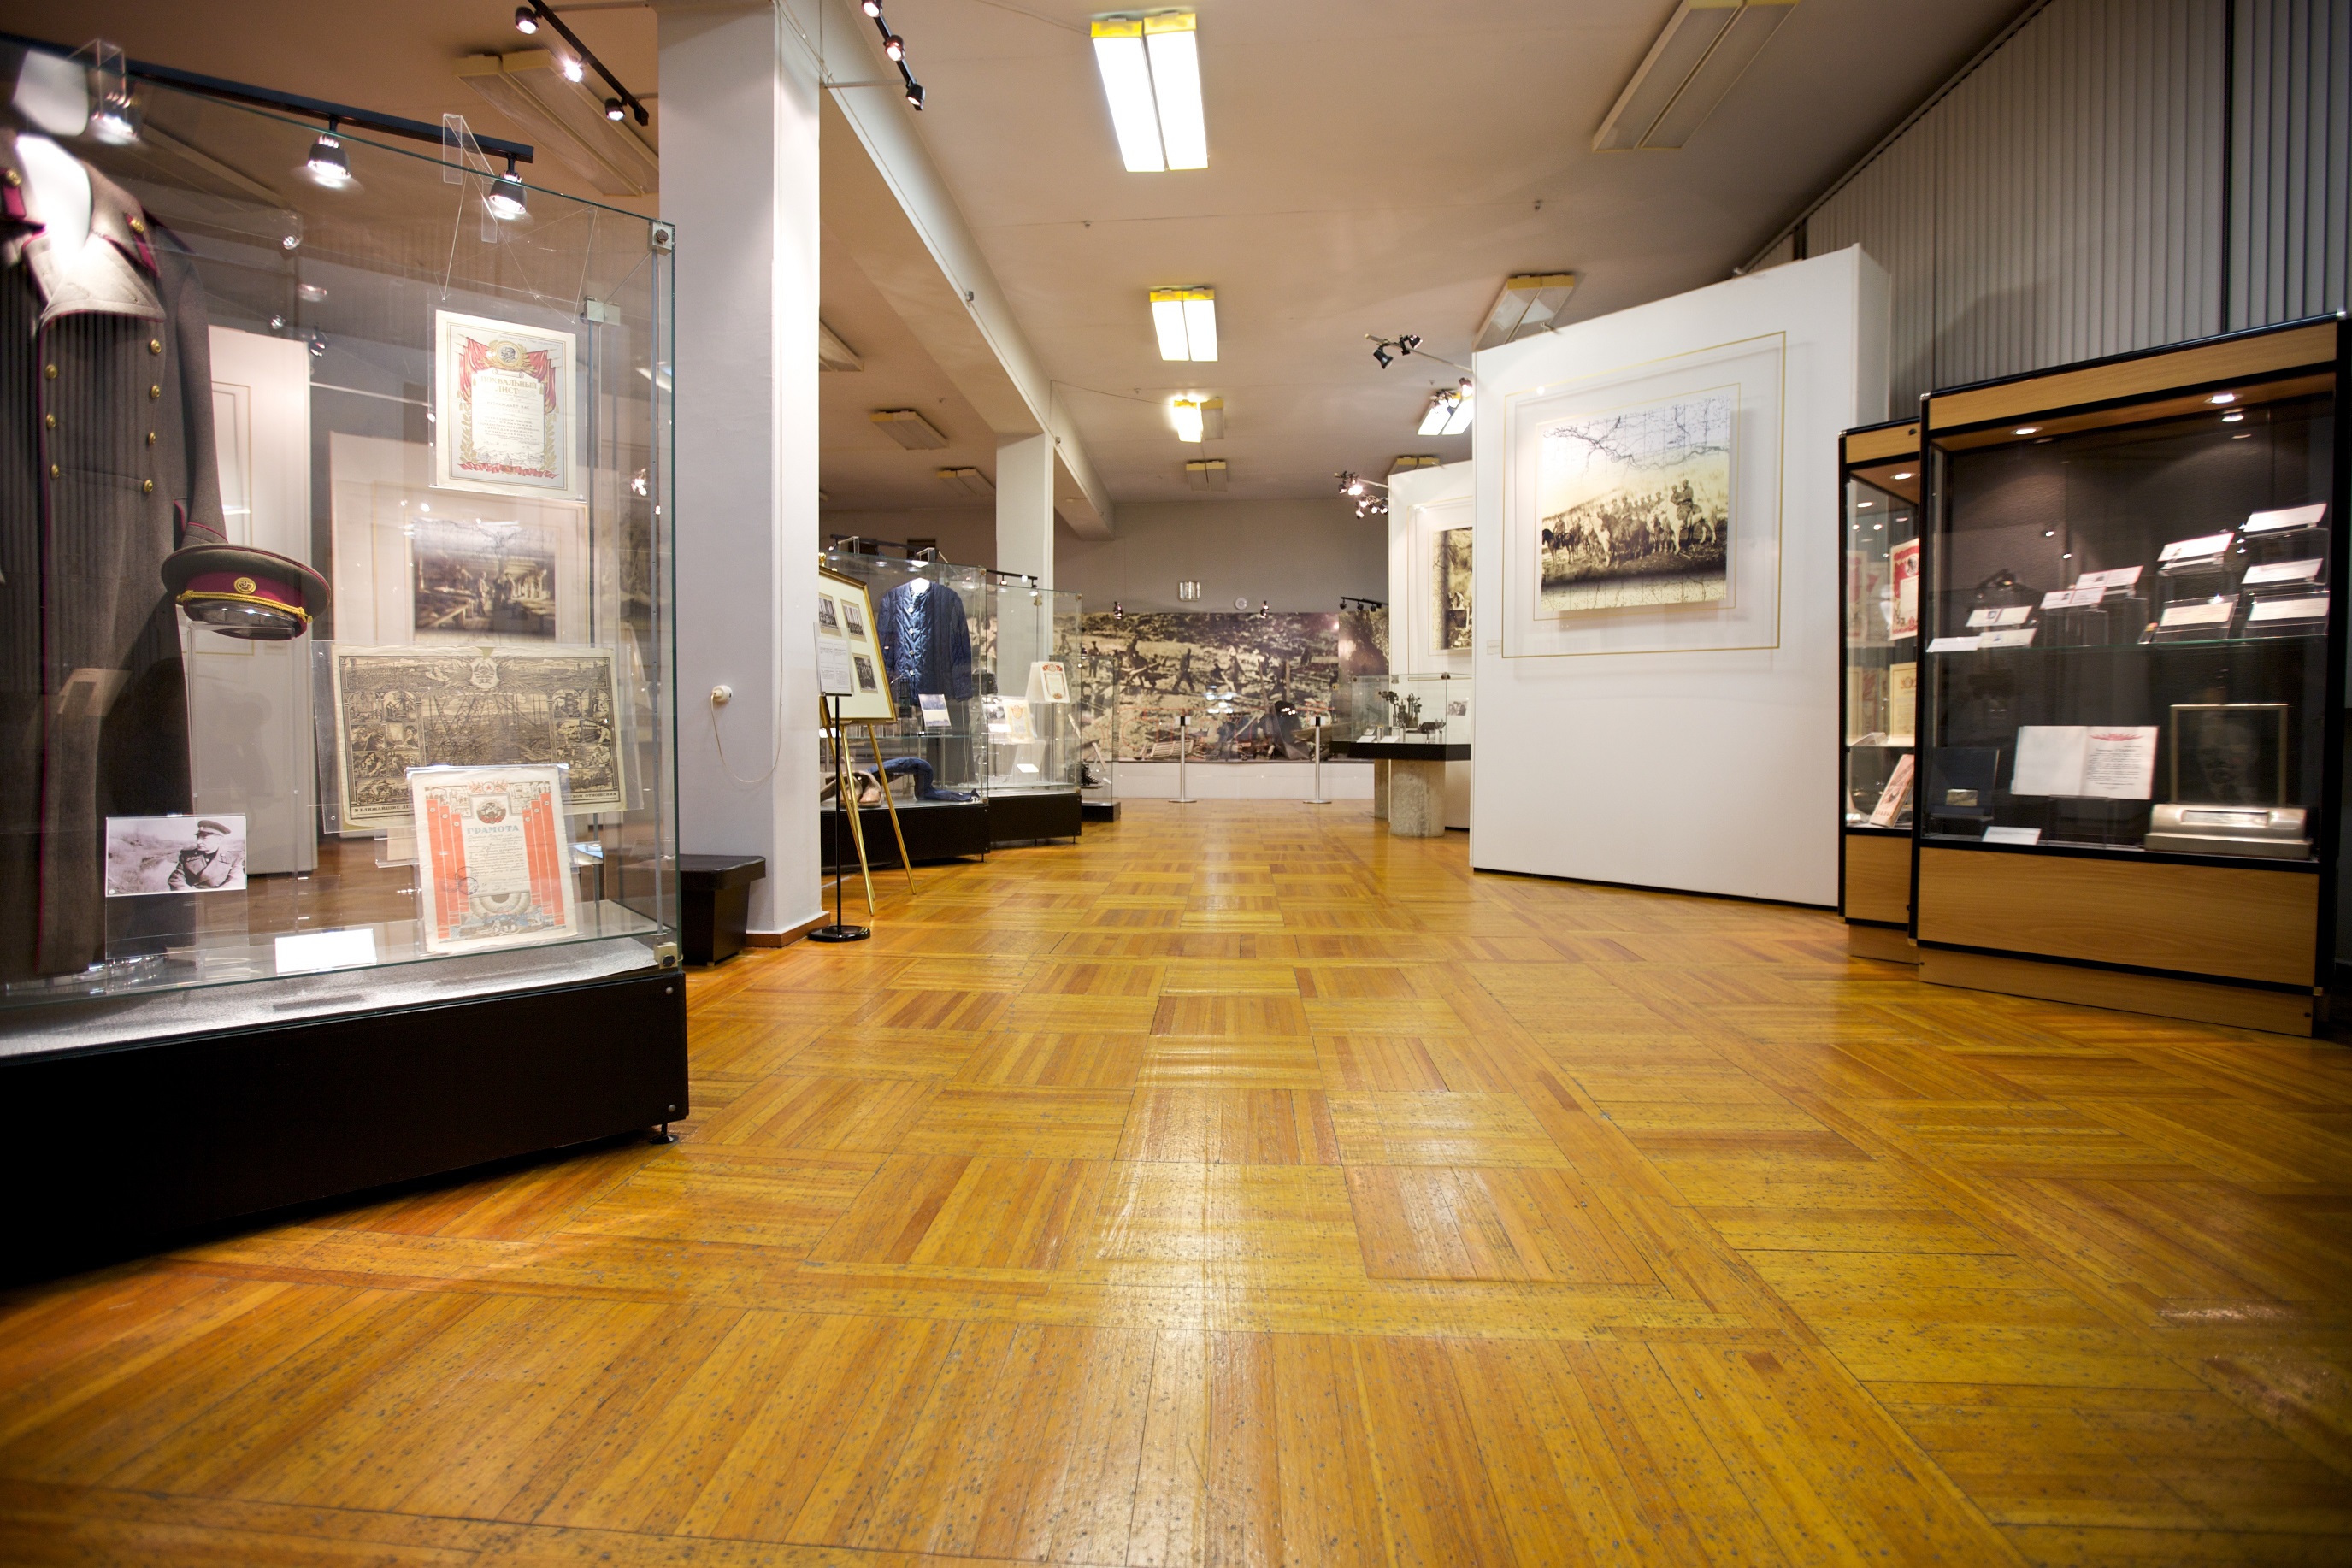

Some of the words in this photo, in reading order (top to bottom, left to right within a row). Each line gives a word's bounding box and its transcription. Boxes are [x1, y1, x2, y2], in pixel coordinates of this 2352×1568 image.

[480, 375, 537, 389] ПОХВАЛЬНЫЙ
[495, 385, 519, 395] ЛИСТ
[467, 825, 519, 834] ГРАМОТА
